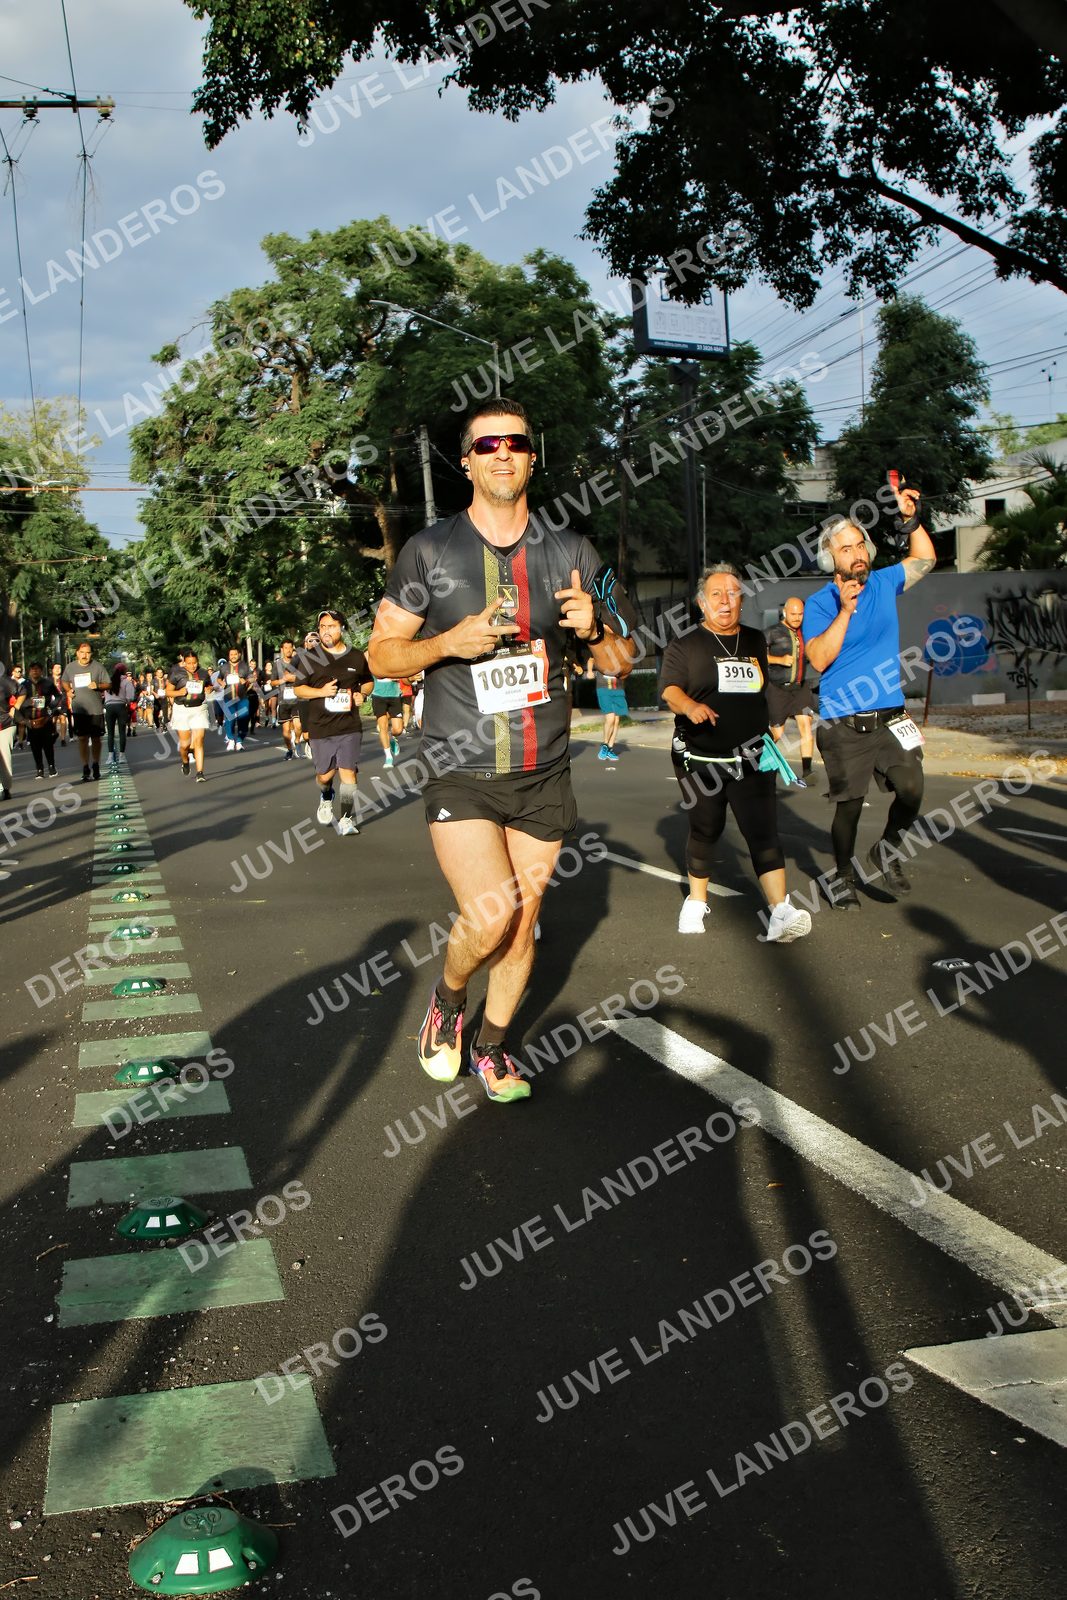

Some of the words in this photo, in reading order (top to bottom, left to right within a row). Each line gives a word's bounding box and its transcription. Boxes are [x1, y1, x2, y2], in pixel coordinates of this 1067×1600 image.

[477, 662, 538, 691] 10821
[724, 666, 754, 679] 3916
[896, 723, 917, 738] 9719
